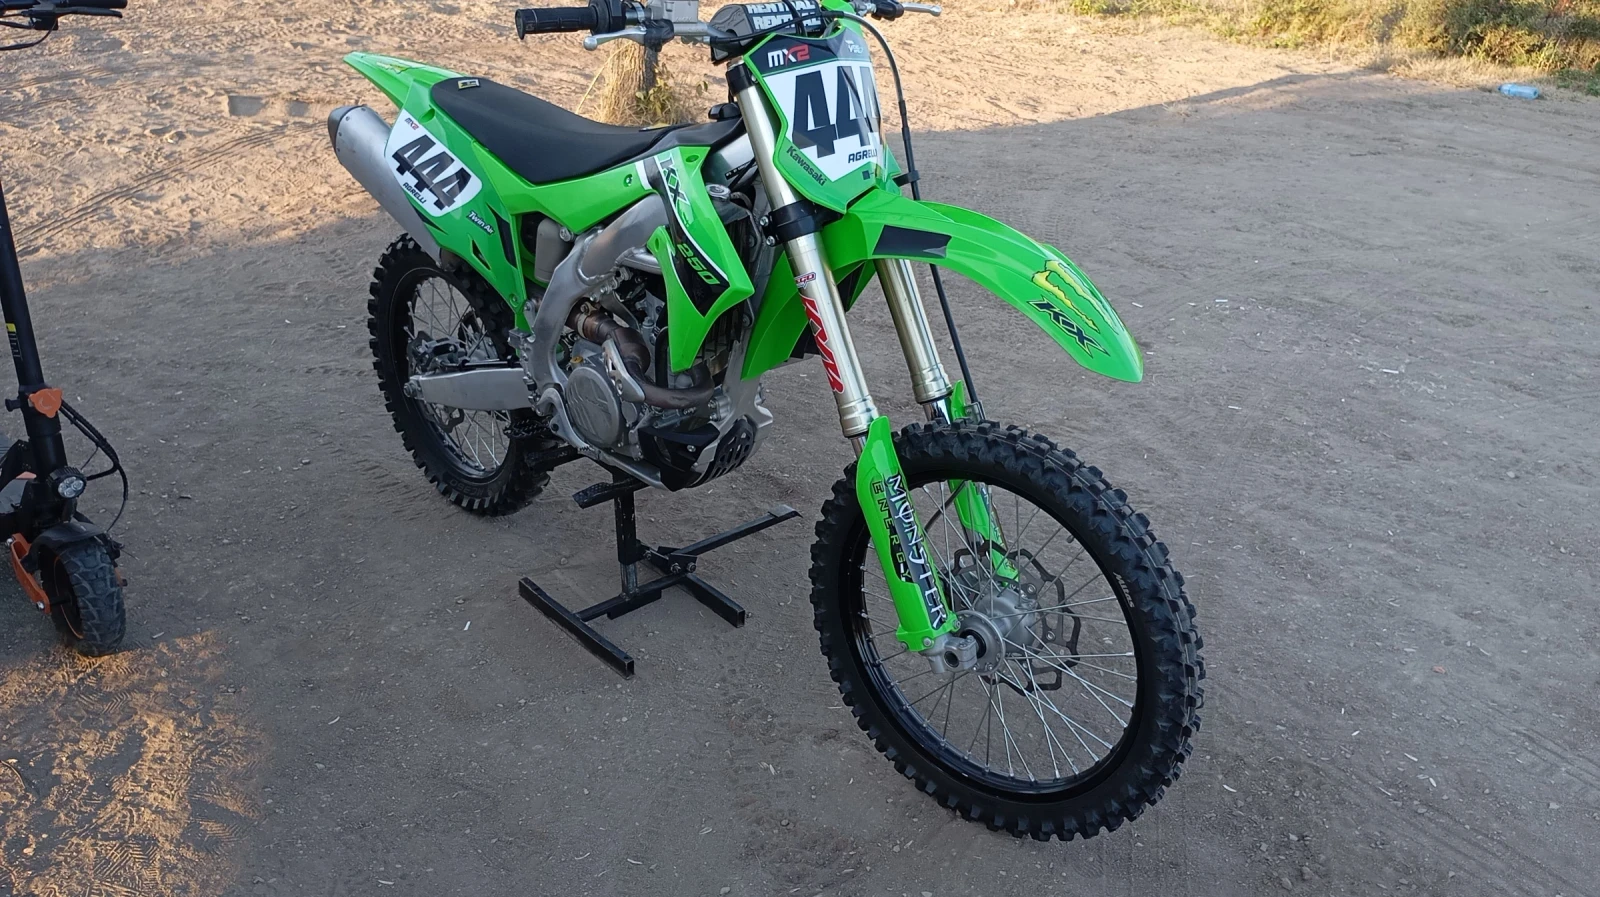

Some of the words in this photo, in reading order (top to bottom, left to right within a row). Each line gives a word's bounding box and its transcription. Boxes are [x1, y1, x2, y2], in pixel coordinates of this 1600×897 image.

[767, 44, 810, 67] MX2
[392, 134, 472, 210] 444
[786, 146, 827, 187] Kawasaki
[402, 182, 427, 204] AGRELLI
[469, 211, 485, 227] Twin
[484, 224, 494, 234] Air
[676, 243, 721, 285] 250
[1026, 295, 1110, 358] KX
[872, 481, 912, 580] ENERGY
[889, 474, 948, 630] MONSTER
